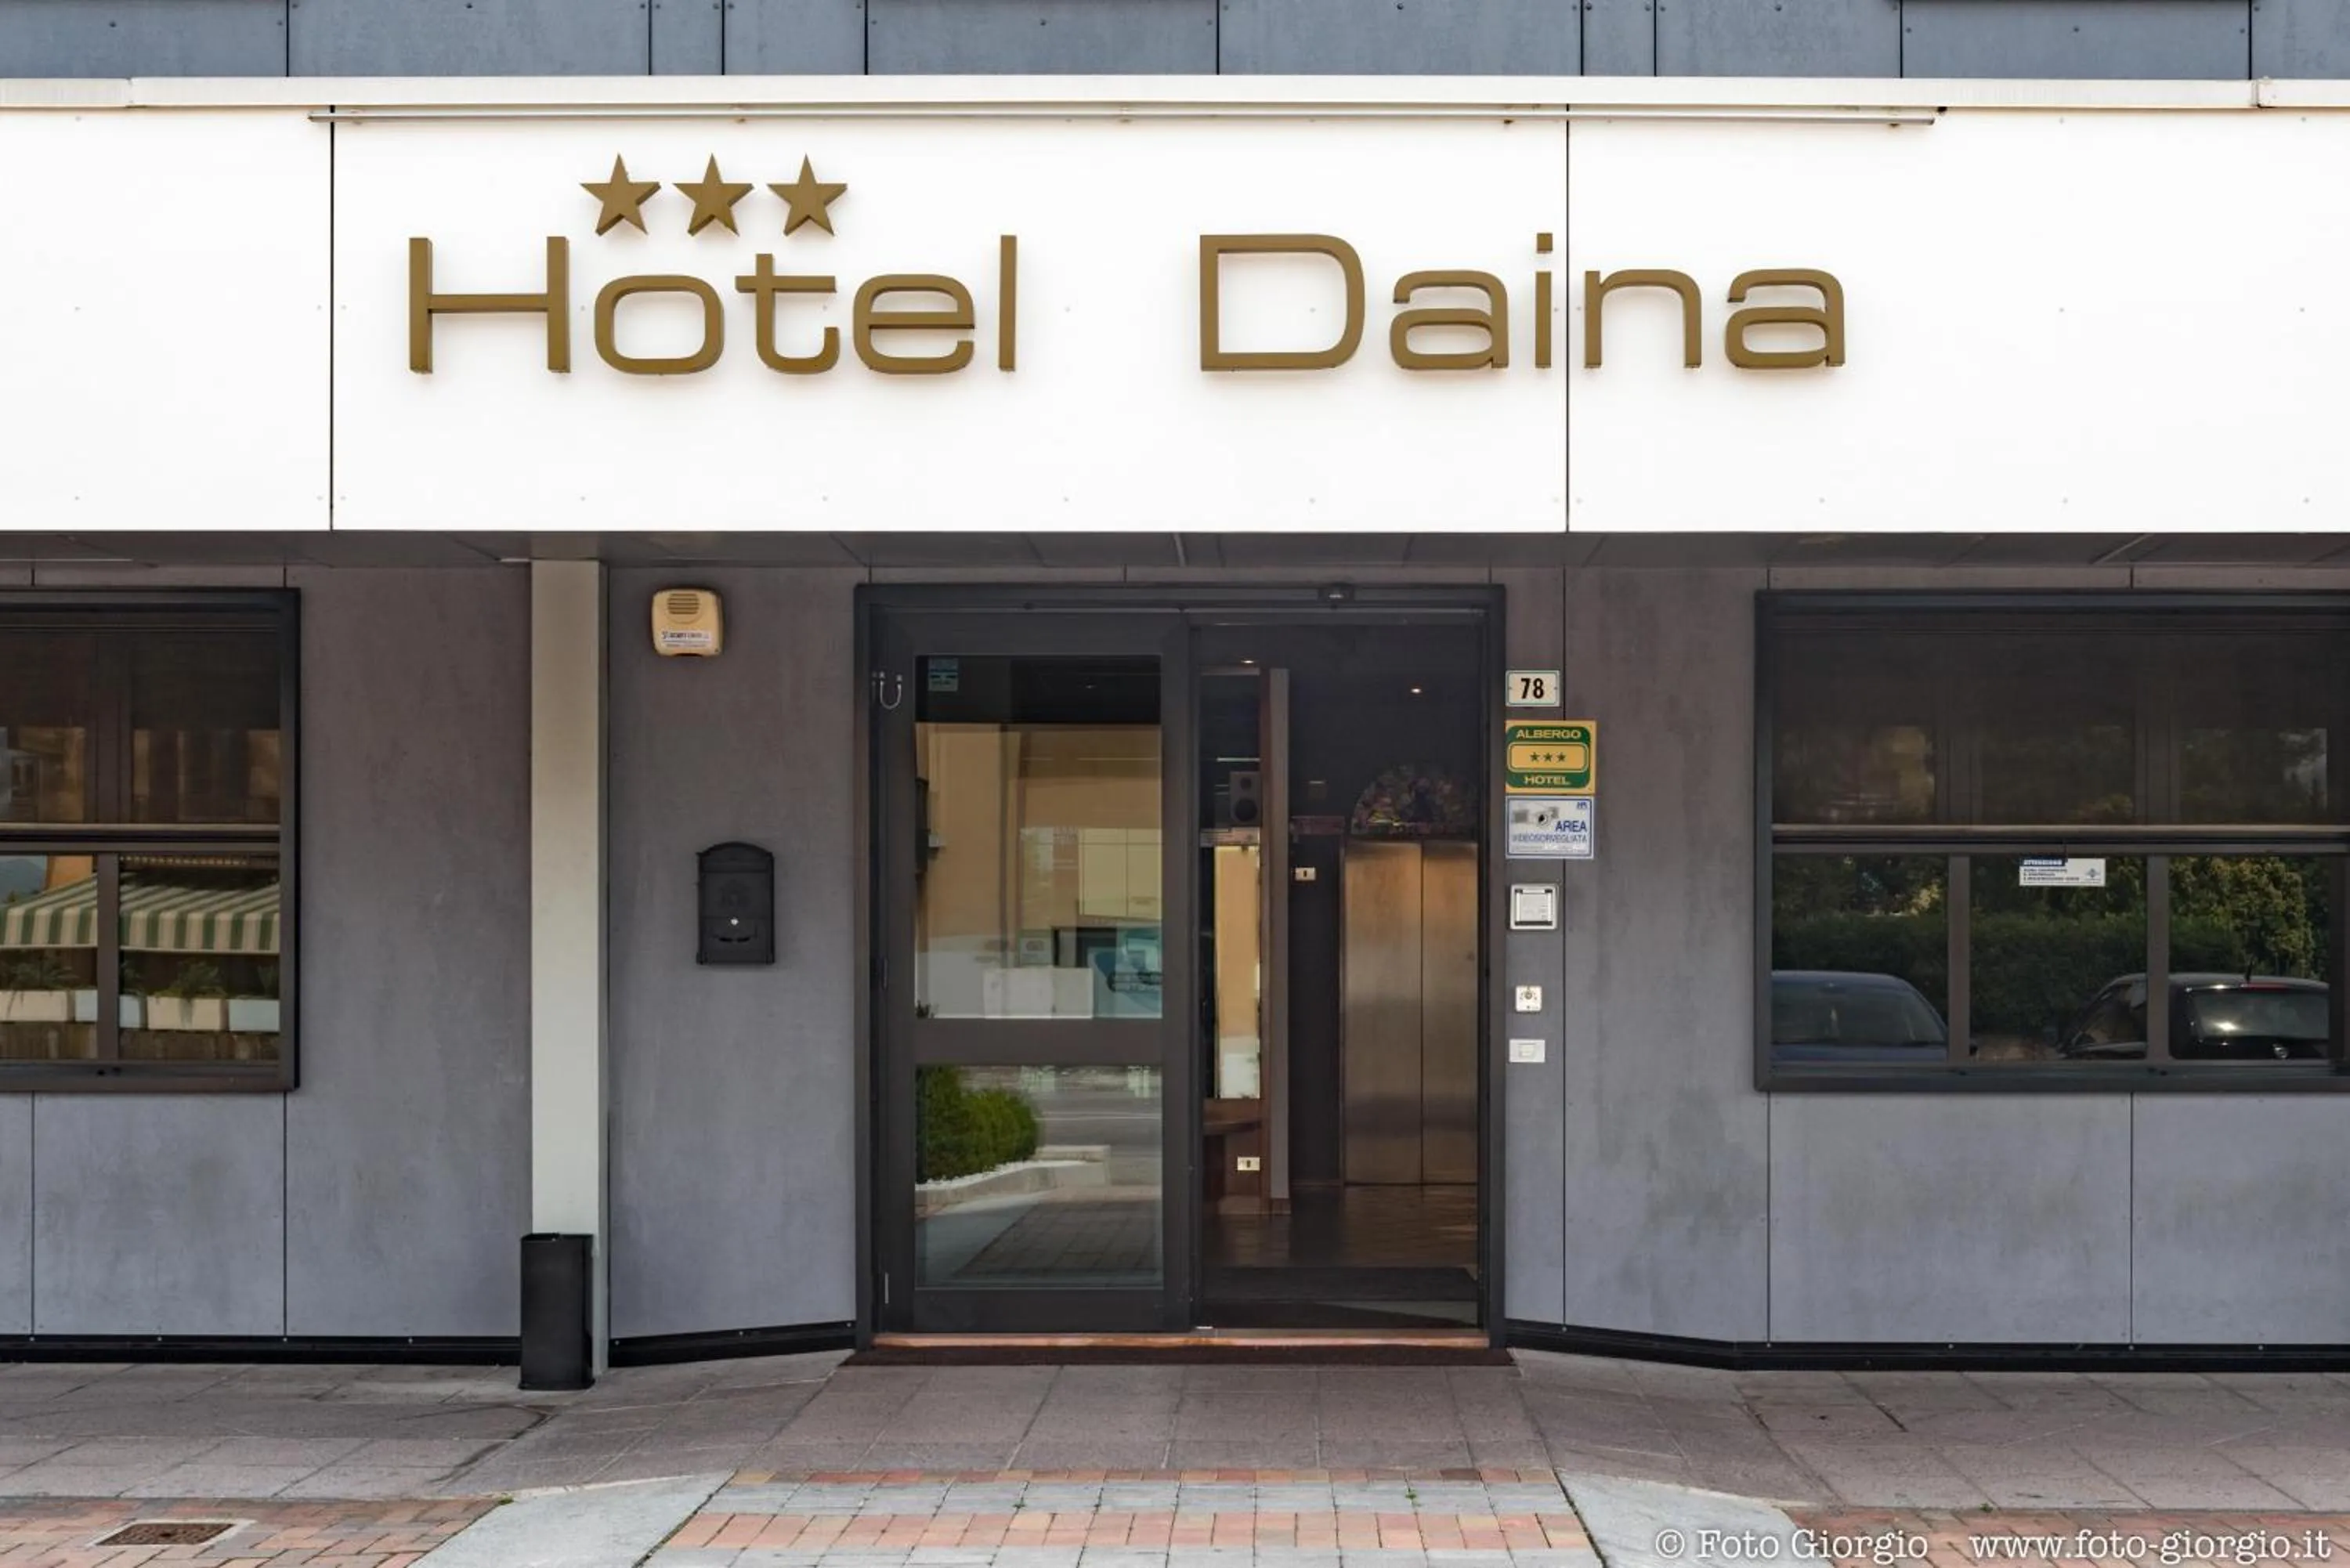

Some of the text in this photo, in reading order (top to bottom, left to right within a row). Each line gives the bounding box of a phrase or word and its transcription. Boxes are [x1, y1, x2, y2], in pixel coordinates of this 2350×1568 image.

[409, 233, 1846, 376] Hotel Daina
[1520, 677, 1544, 699] 78
[1516, 729, 1581, 739] ALBERGO
[1524, 775, 1569, 785] HOTEL
[1556, 820, 1587, 832] AREA
